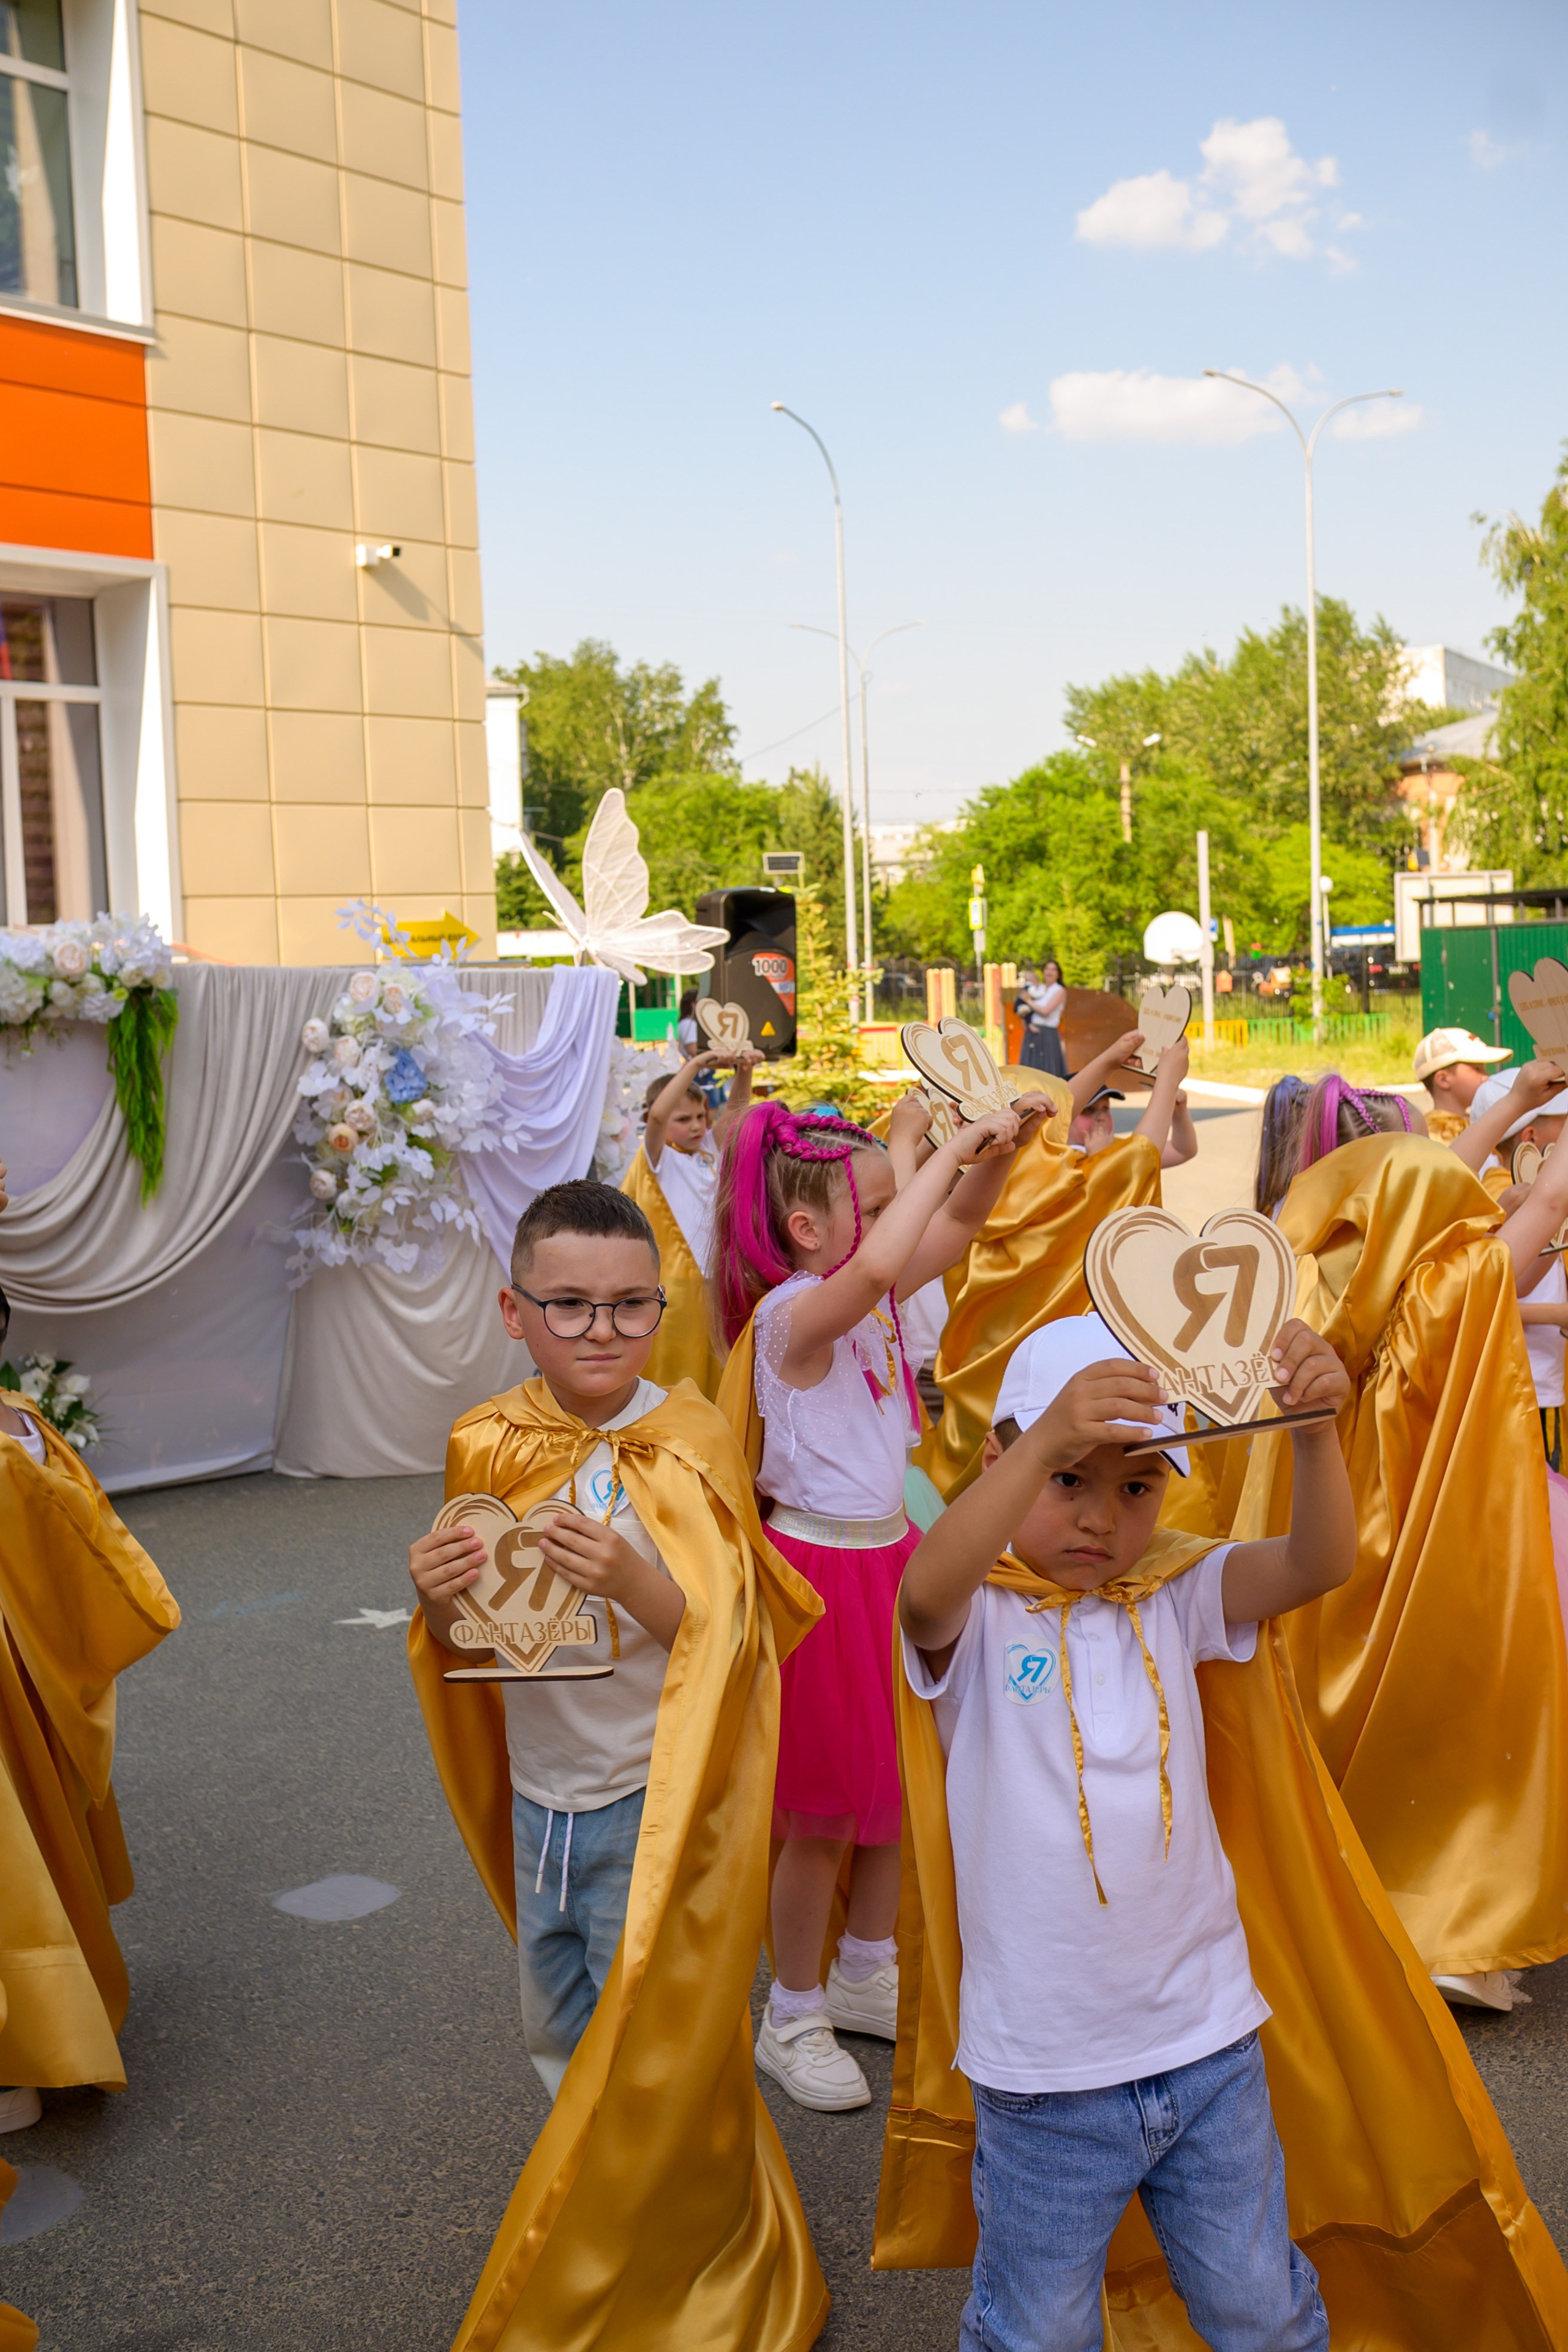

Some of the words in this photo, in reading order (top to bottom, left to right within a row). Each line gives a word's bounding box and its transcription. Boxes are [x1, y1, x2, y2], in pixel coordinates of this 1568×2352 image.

[753, 958, 788, 974] 1000
[717, 1011, 738, 1038] Я
[941, 1034, 989, 1091] Я
[1173, 1242, 1259, 1353] Я
[1156, 1352, 1277, 1396] АНТАЗЁ
[488, 1526, 557, 1611] Я
[454, 1618, 591, 1644] ФАНТАЗЁРЫ
[1017, 1654, 1047, 1683] Я
